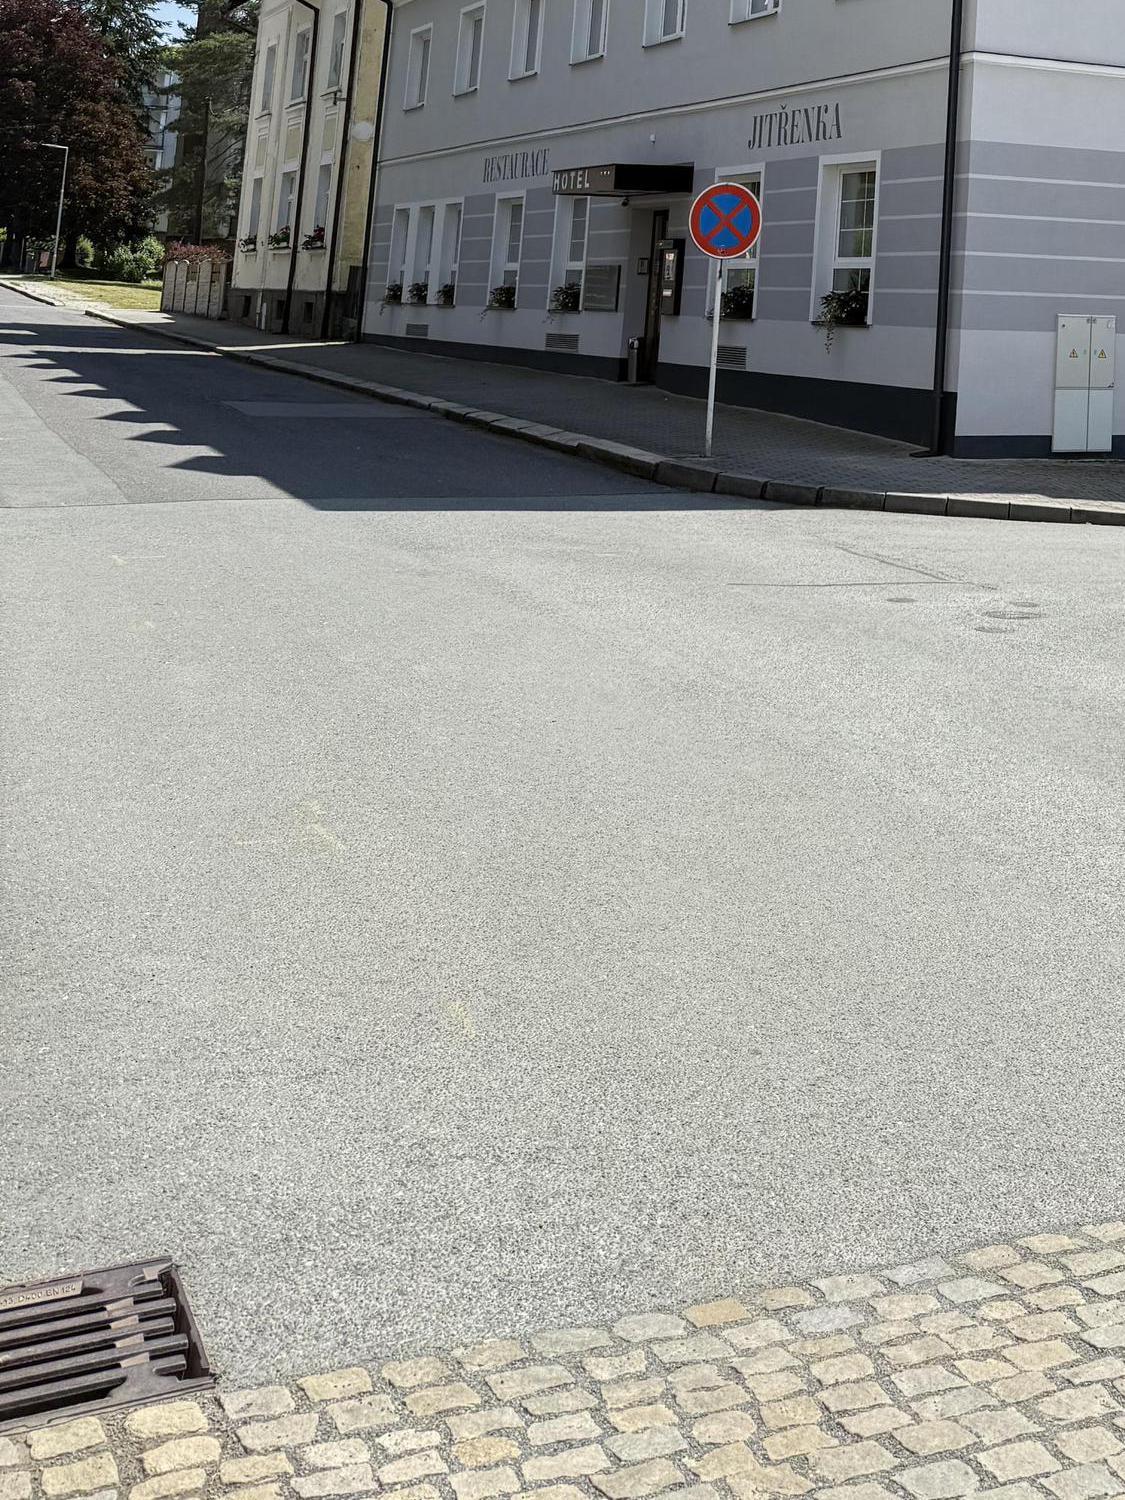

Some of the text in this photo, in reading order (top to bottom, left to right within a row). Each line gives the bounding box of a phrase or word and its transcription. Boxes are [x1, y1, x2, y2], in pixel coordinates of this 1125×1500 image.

[748, 102, 842, 150] JITŘENKA
[483, 148, 550, 183] RESTAURACE
[553, 169, 590, 191] HOTEL
